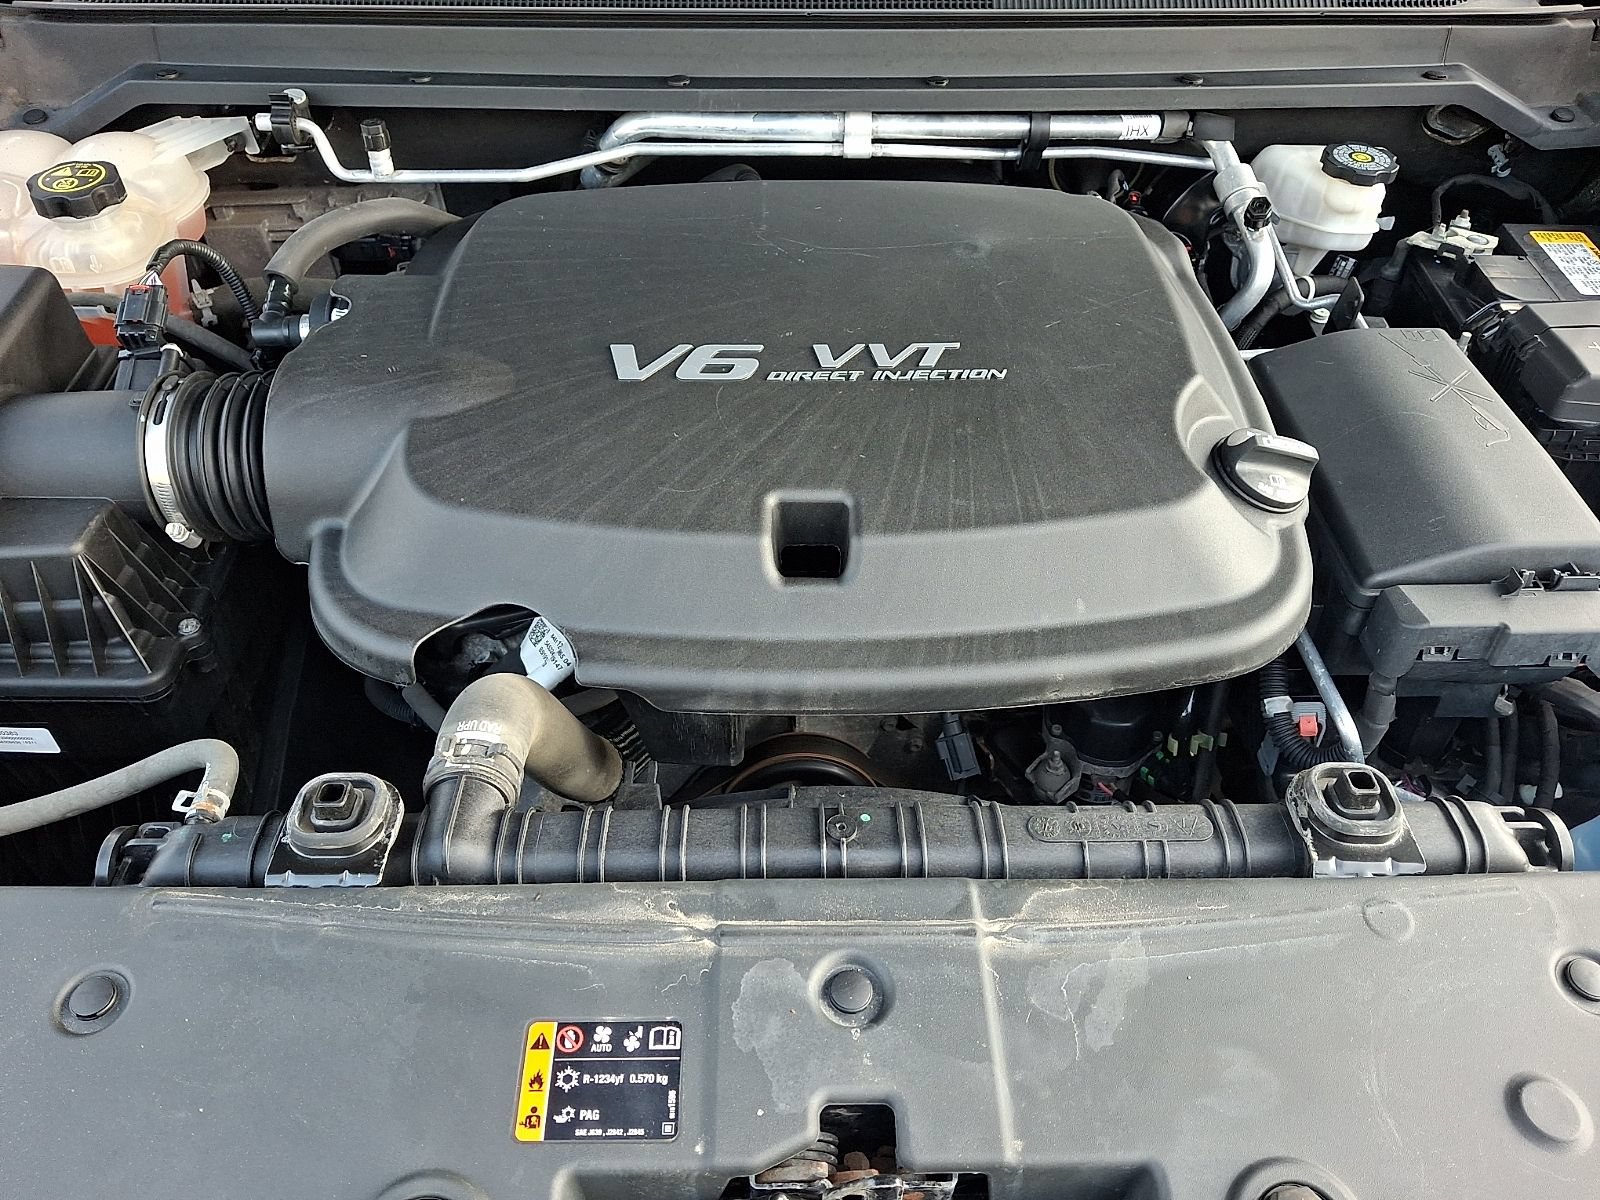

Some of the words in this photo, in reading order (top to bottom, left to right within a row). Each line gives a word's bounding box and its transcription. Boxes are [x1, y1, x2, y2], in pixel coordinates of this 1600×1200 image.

[609, 343, 765, 382] V6
[812, 341, 962, 369] VVT
[766, 370, 865, 383] DIRECT
[871, 368, 1009, 382] INJECTION
[456, 719, 478, 732] UPR
[590, 1043, 613, 1053] AUTO
[582, 1073, 625, 1086] R-1234yf
[629, 1073, 655, 1084] 0.570
[656, 1073, 669, 1086] kg
[579, 1109, 600, 1121] PAG
